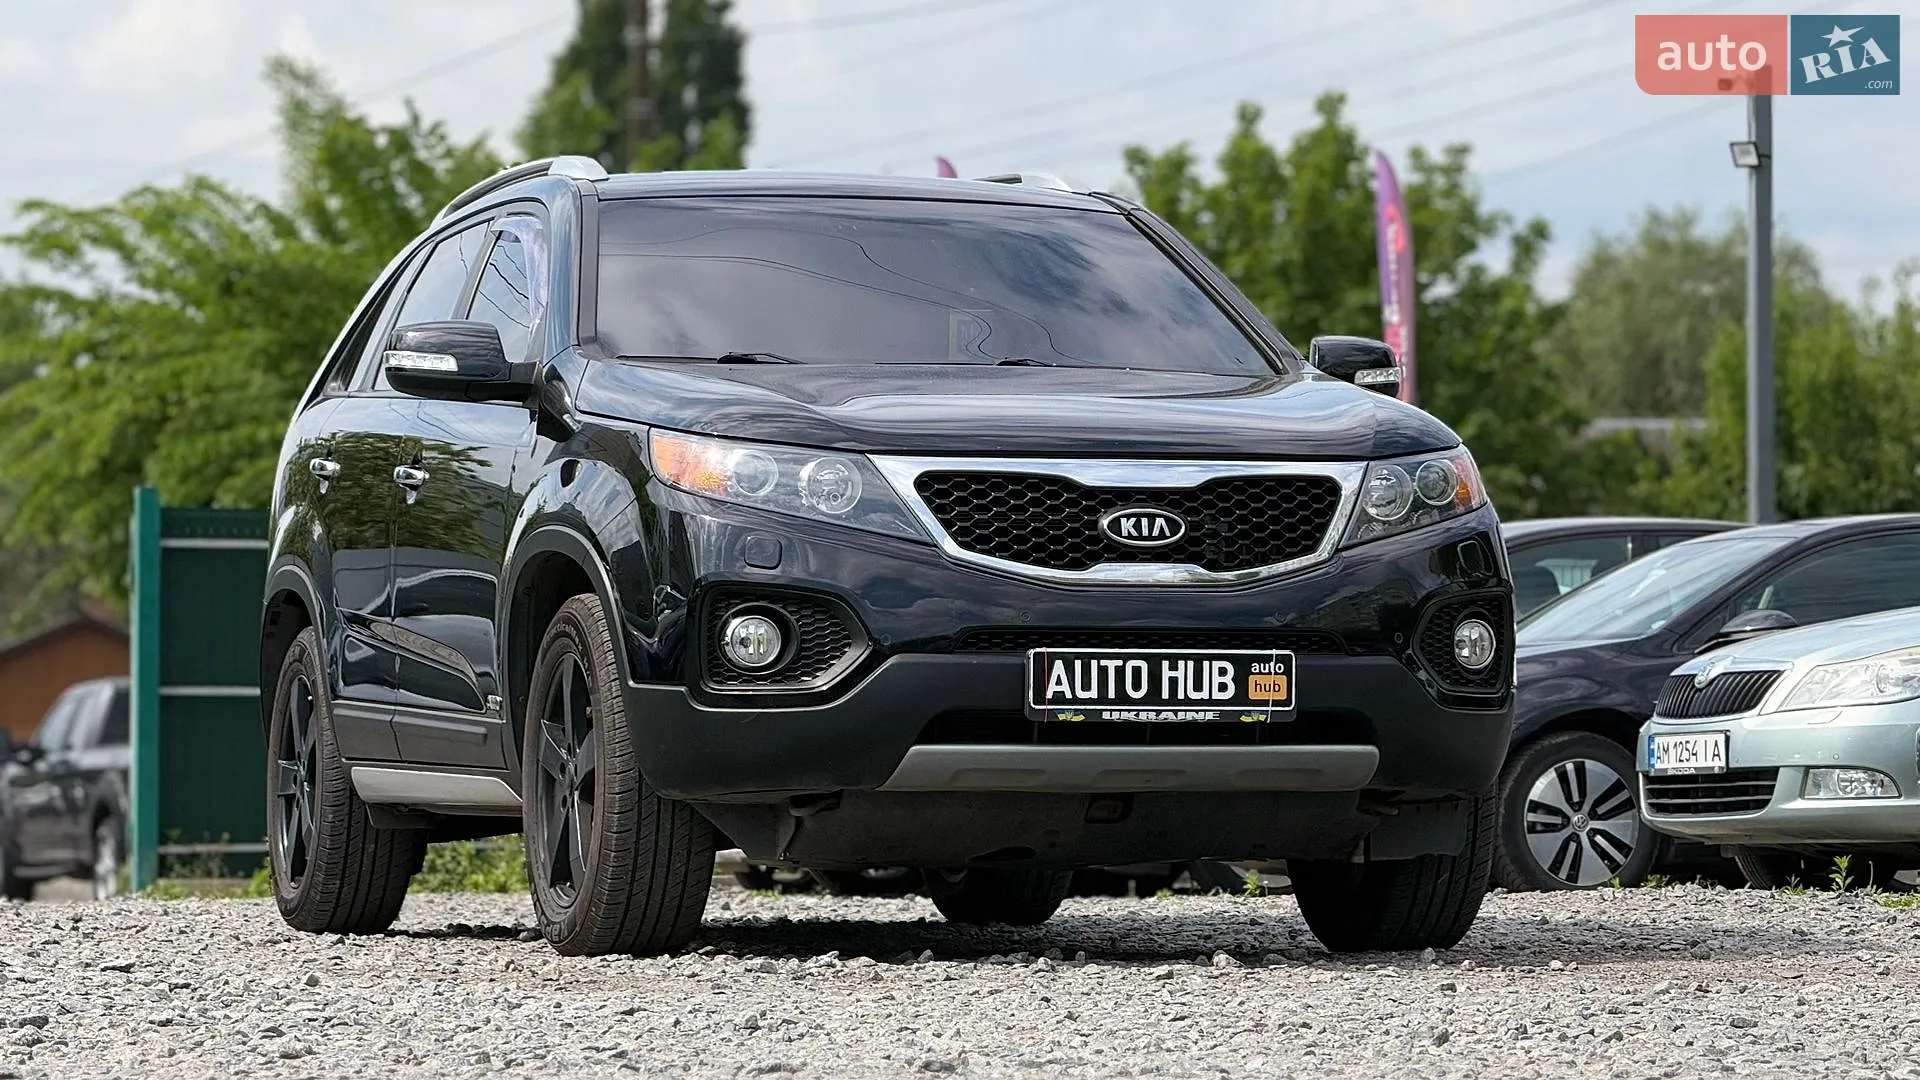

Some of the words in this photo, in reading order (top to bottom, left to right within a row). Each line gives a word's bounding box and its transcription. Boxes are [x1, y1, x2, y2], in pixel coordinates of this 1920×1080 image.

[1120, 517, 1171, 537] KIA
[1251, 661, 1285, 673] auto
[1046, 659, 1149, 699] AUTO
[1161, 660, 1236, 700] HUB
[1254, 680, 1281, 692] hub
[1102, 711, 1221, 720] UKRAINE
[1656, 741, 1670, 764] AM
[1673, 740, 1698, 763] 1254
